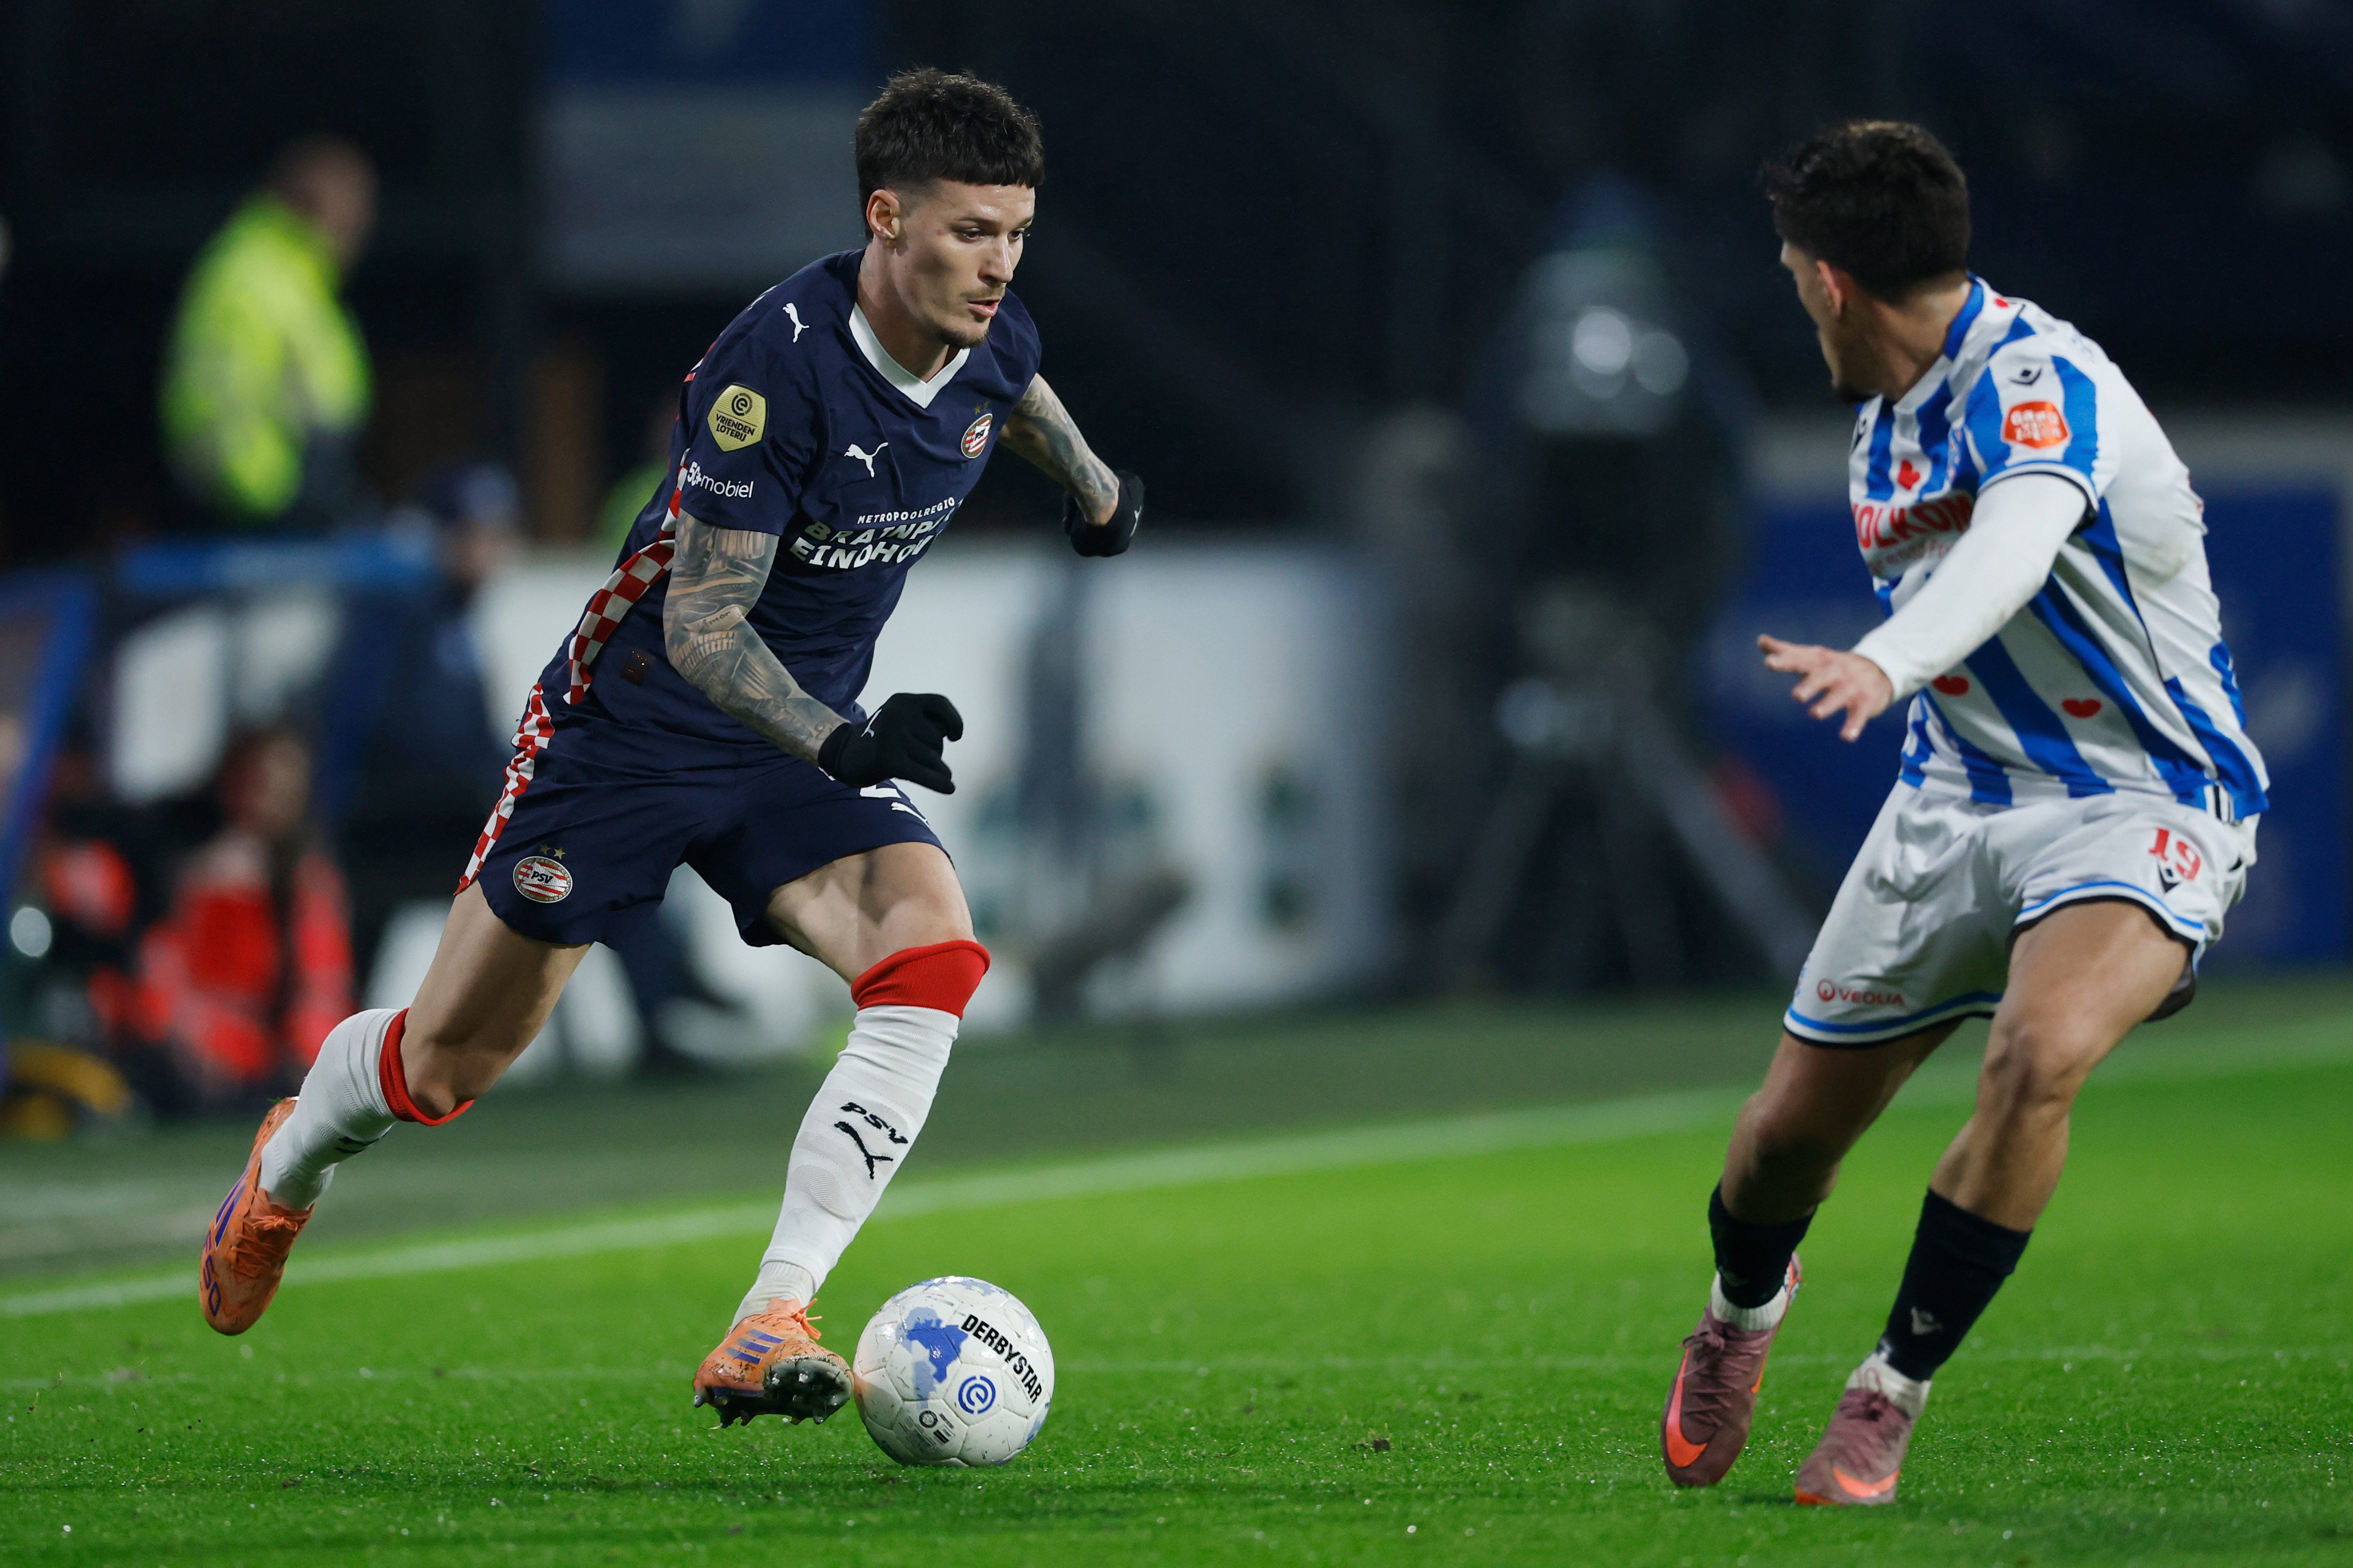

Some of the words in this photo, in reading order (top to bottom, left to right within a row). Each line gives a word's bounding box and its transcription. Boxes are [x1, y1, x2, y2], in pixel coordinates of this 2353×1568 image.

[716, 414, 755, 436] VRIENDEN
[716, 424, 747, 442] LOTERIJ
[857, 497, 955, 525] METROPOOLREGIO
[790, 528, 944, 569] EINDHOV
[2148, 827, 2201, 882] 19
[531, 871, 553, 883] PSV
[1839, 988, 1904, 1006] VEOLIA
[841, 1102, 908, 1144] PSV
[961, 1314, 1042, 1404] DERBYSTAR
